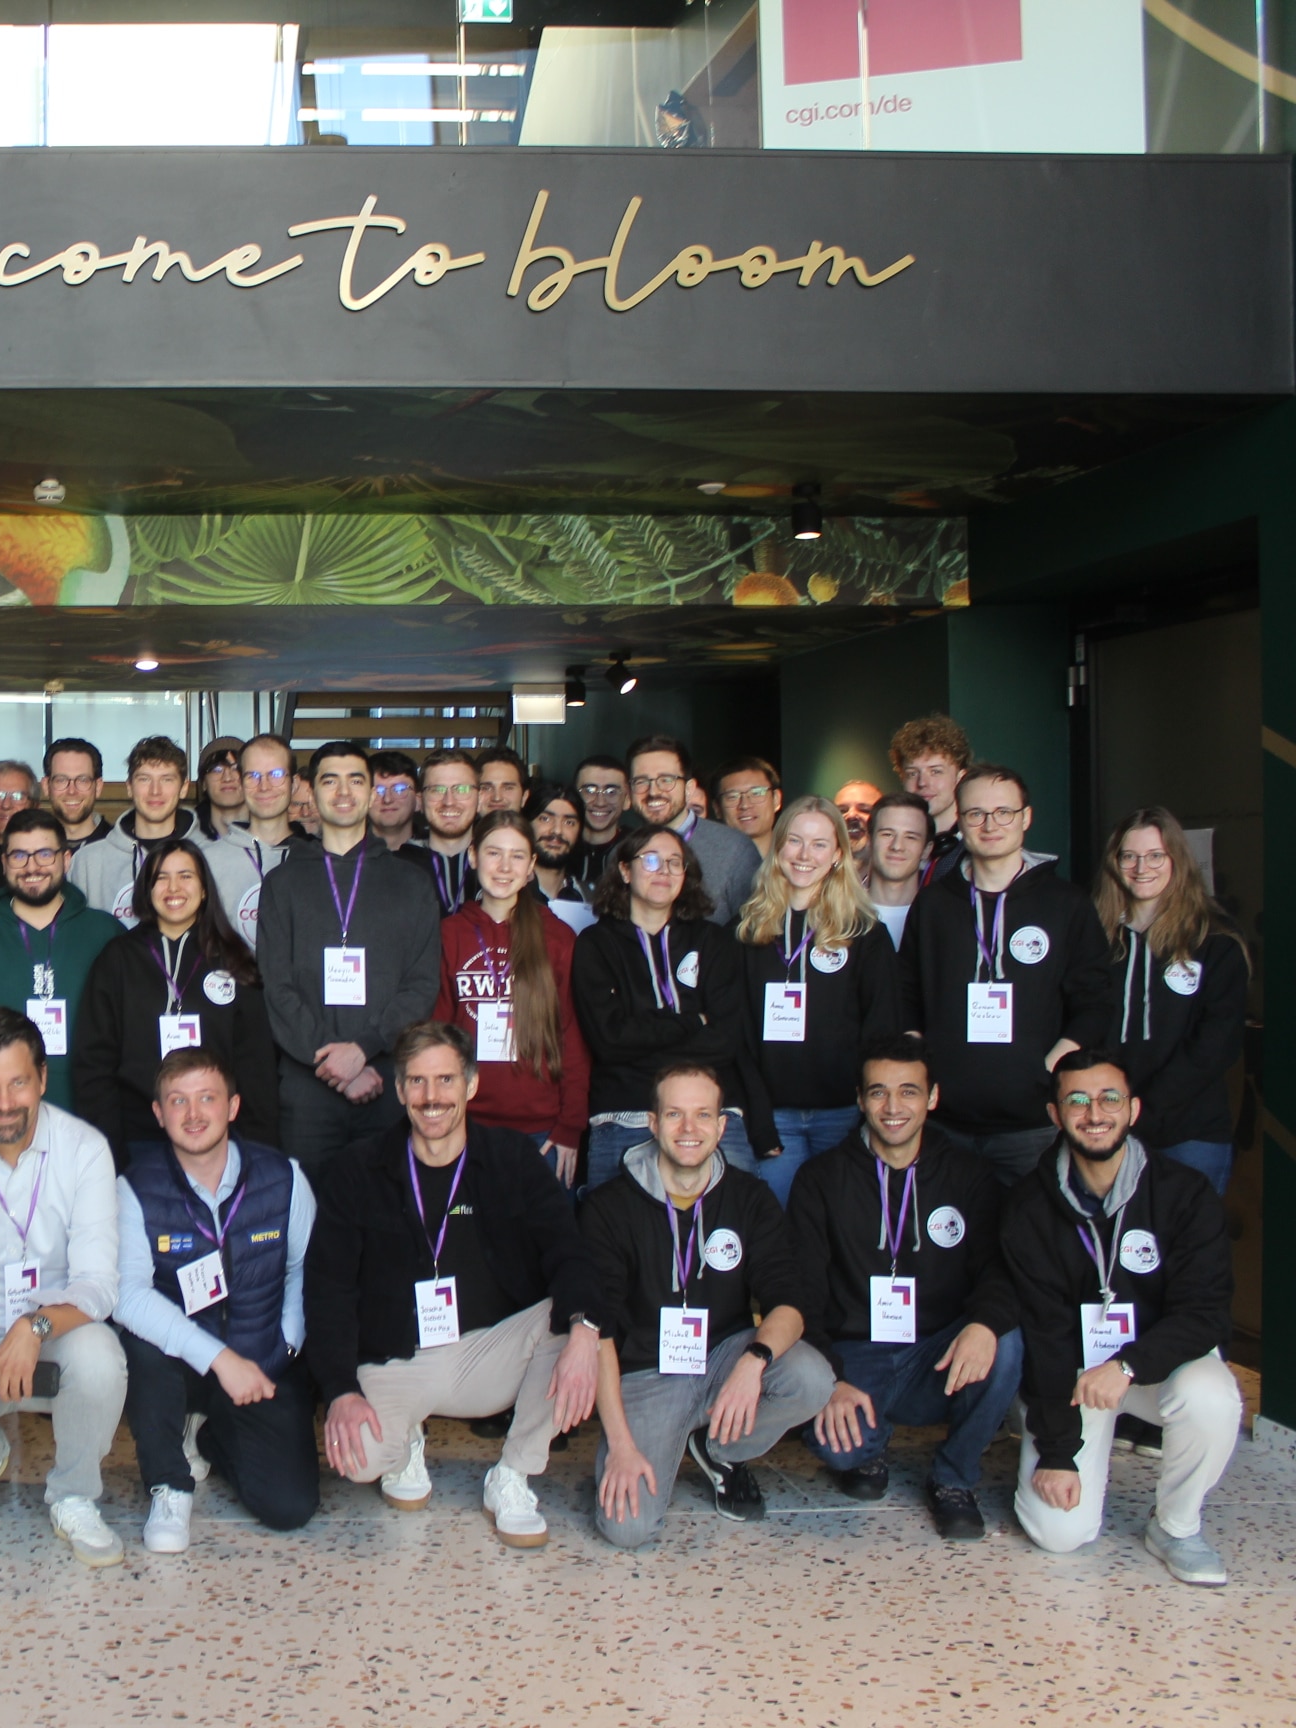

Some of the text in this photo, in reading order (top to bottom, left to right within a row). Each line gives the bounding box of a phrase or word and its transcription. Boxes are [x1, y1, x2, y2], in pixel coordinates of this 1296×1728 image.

[785, 95, 912, 127] cgi.com/de
[288, 194, 486, 312] to
[507, 189, 916, 313] bloom
[113, 907, 134, 918] CG
[240, 909, 259, 920] CG
[456, 975, 514, 997] RWT
[251, 1229, 281, 1244] METRO
